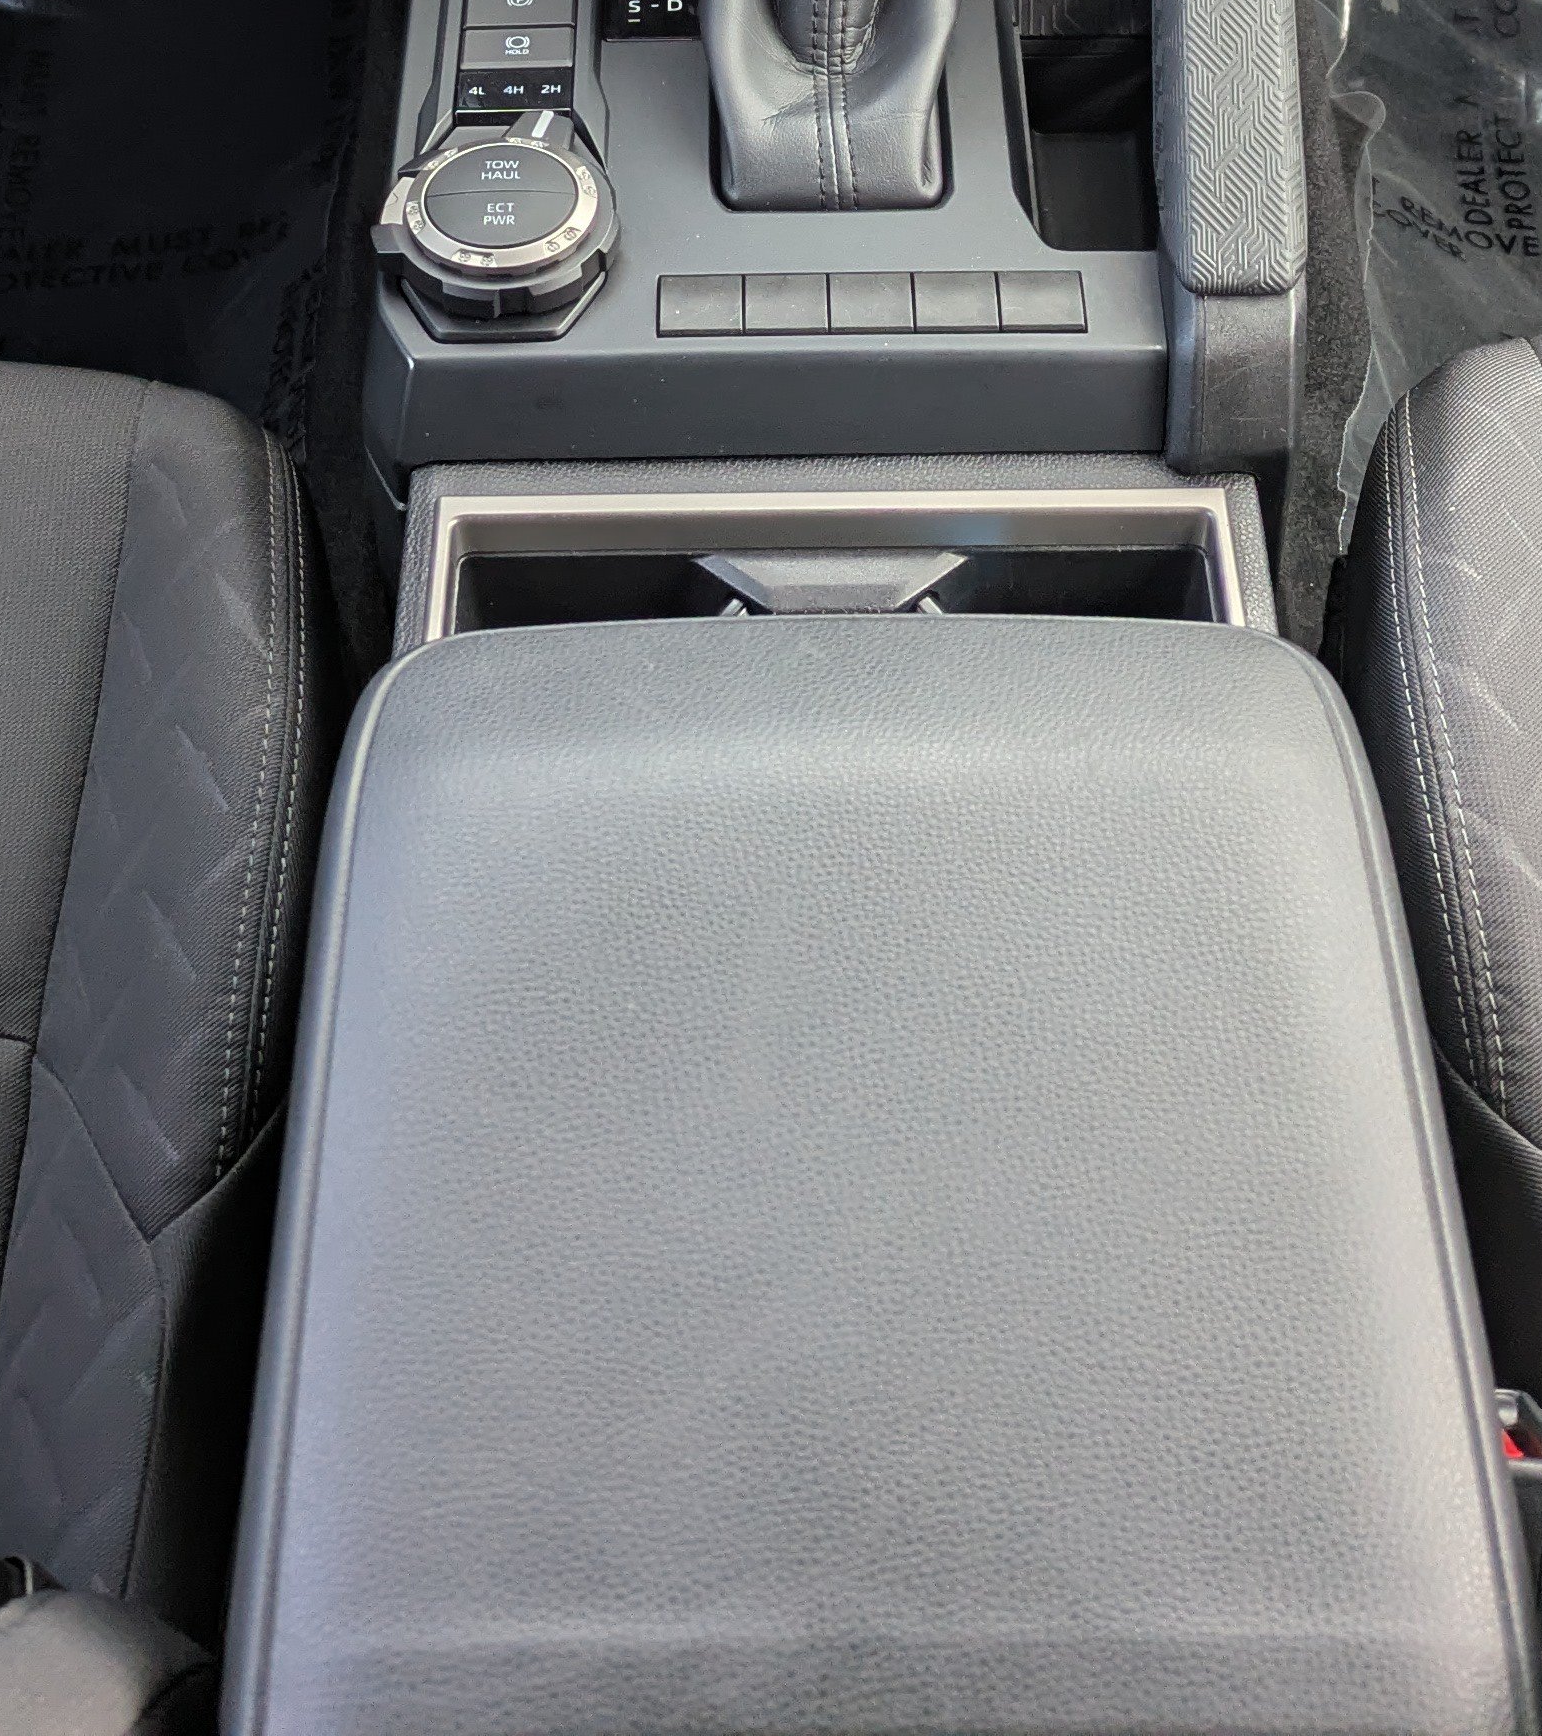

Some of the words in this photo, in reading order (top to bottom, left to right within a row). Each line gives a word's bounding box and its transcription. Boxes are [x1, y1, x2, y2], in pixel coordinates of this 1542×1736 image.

[628, 0, 641, 13] S
[667, 0, 683, 12] D
[469, 86, 486, 95] 4L
[503, 85, 524, 95] 4H
[541, 84, 561, 94] 2H
[485, 160, 520, 170] TOW
[481, 170, 521, 180] HAUL
[1455, 129, 1494, 226] DEALER
[487, 202, 515, 213] ECT
[483, 215, 515, 225] PWR
